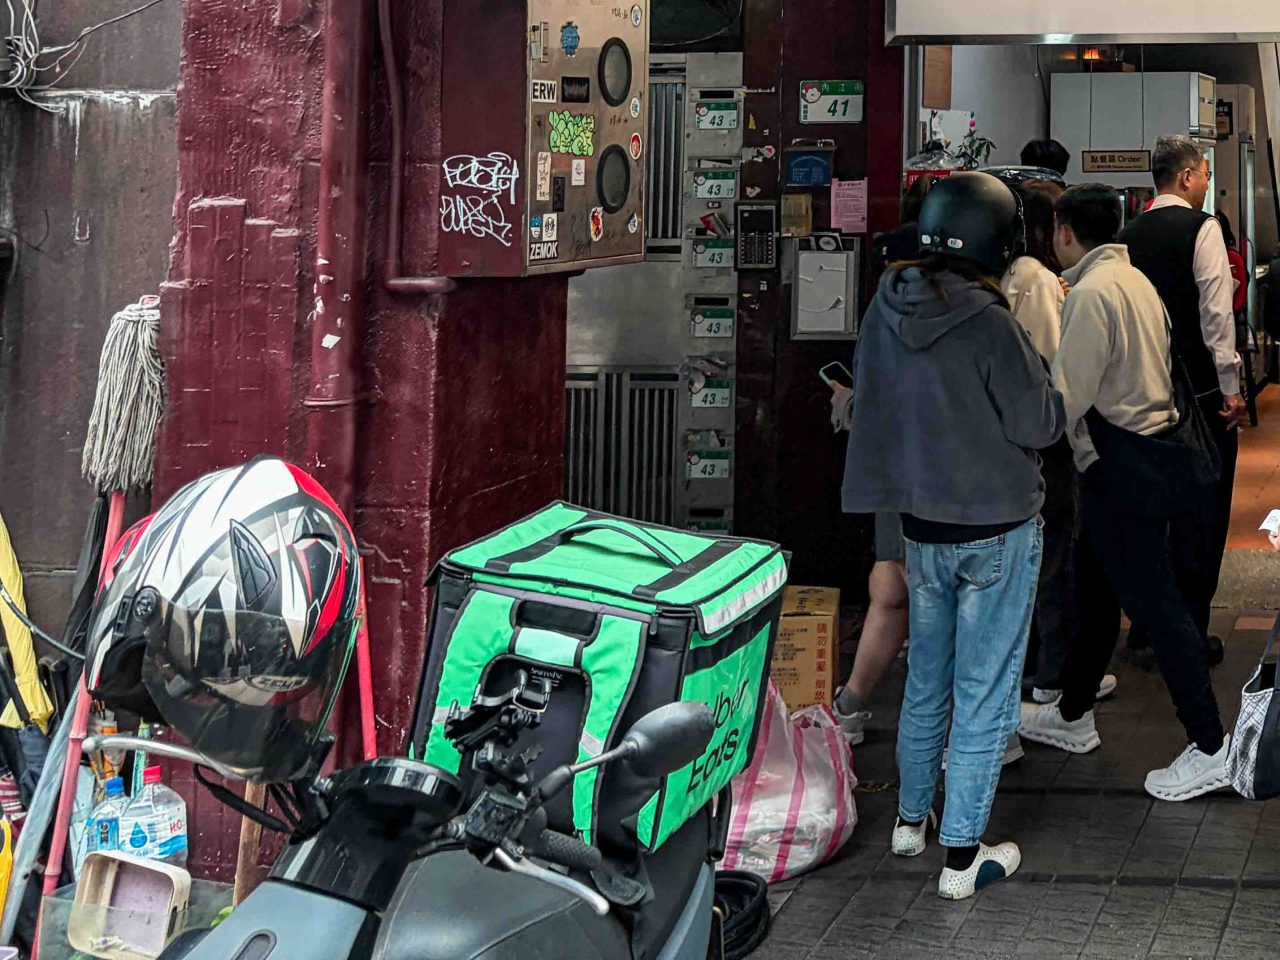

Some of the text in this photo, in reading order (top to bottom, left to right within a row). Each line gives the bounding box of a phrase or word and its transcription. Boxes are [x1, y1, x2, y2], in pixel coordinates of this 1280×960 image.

[533, 82, 556, 100] ERW
[827, 99, 850, 117] 41
[709, 115, 724, 127] 43
[1118, 155, 1142, 163] Order
[707, 184, 722, 196] 43
[530, 242, 558, 259] ZEMOK
[708, 252, 723, 264] 43
[706, 322, 721, 335] 43
[702, 393, 717, 405] 43
[701, 464, 716, 476] 43
